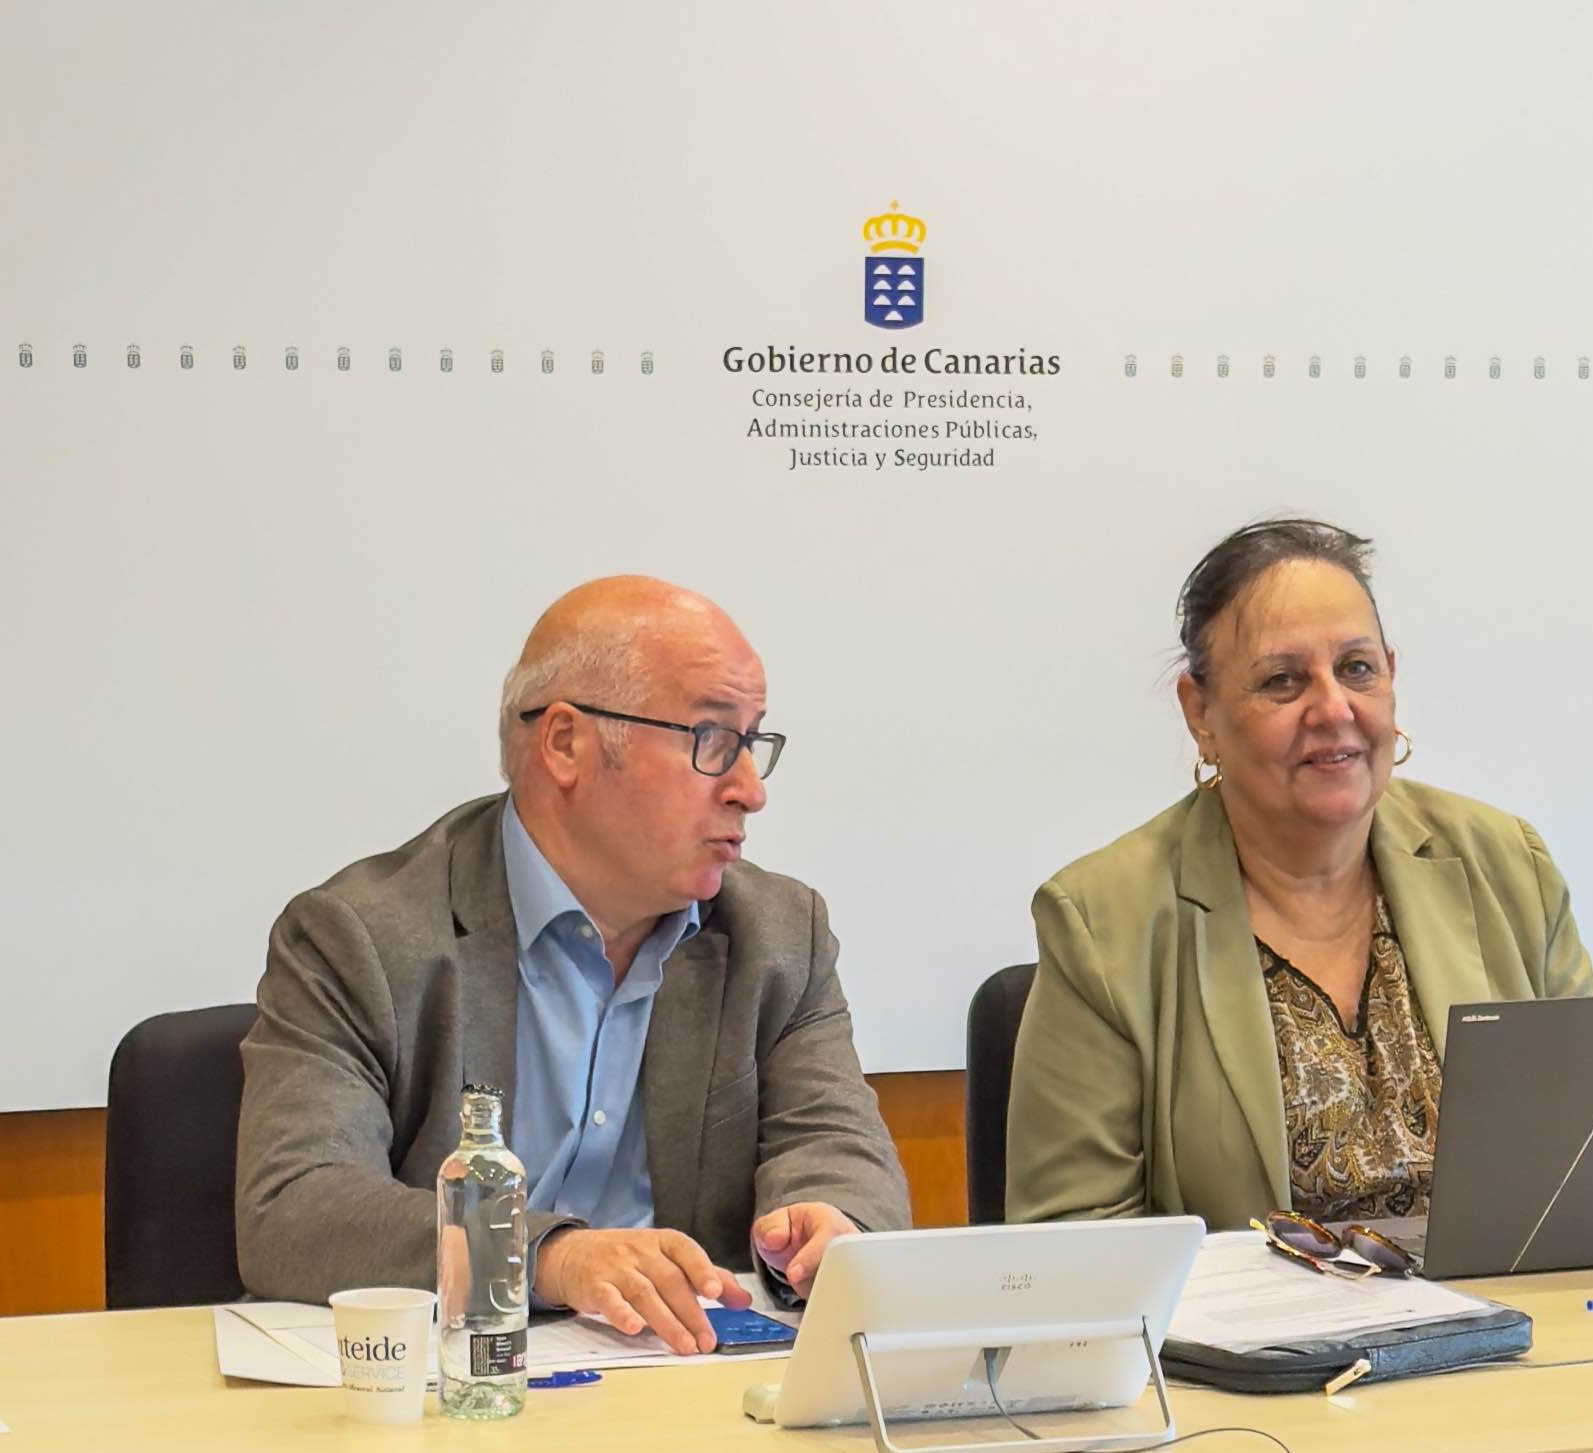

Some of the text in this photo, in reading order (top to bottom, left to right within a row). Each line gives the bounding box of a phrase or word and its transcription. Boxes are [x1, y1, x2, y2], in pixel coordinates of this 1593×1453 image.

[722, 345, 1061, 376] Gobierno de Canarias
[751, 388, 1033, 413] Consejería de Presidencia,
[746, 417, 1038, 441] Administraciones Públicas,
[789, 447, 995, 472] Justicia y Seguridad
